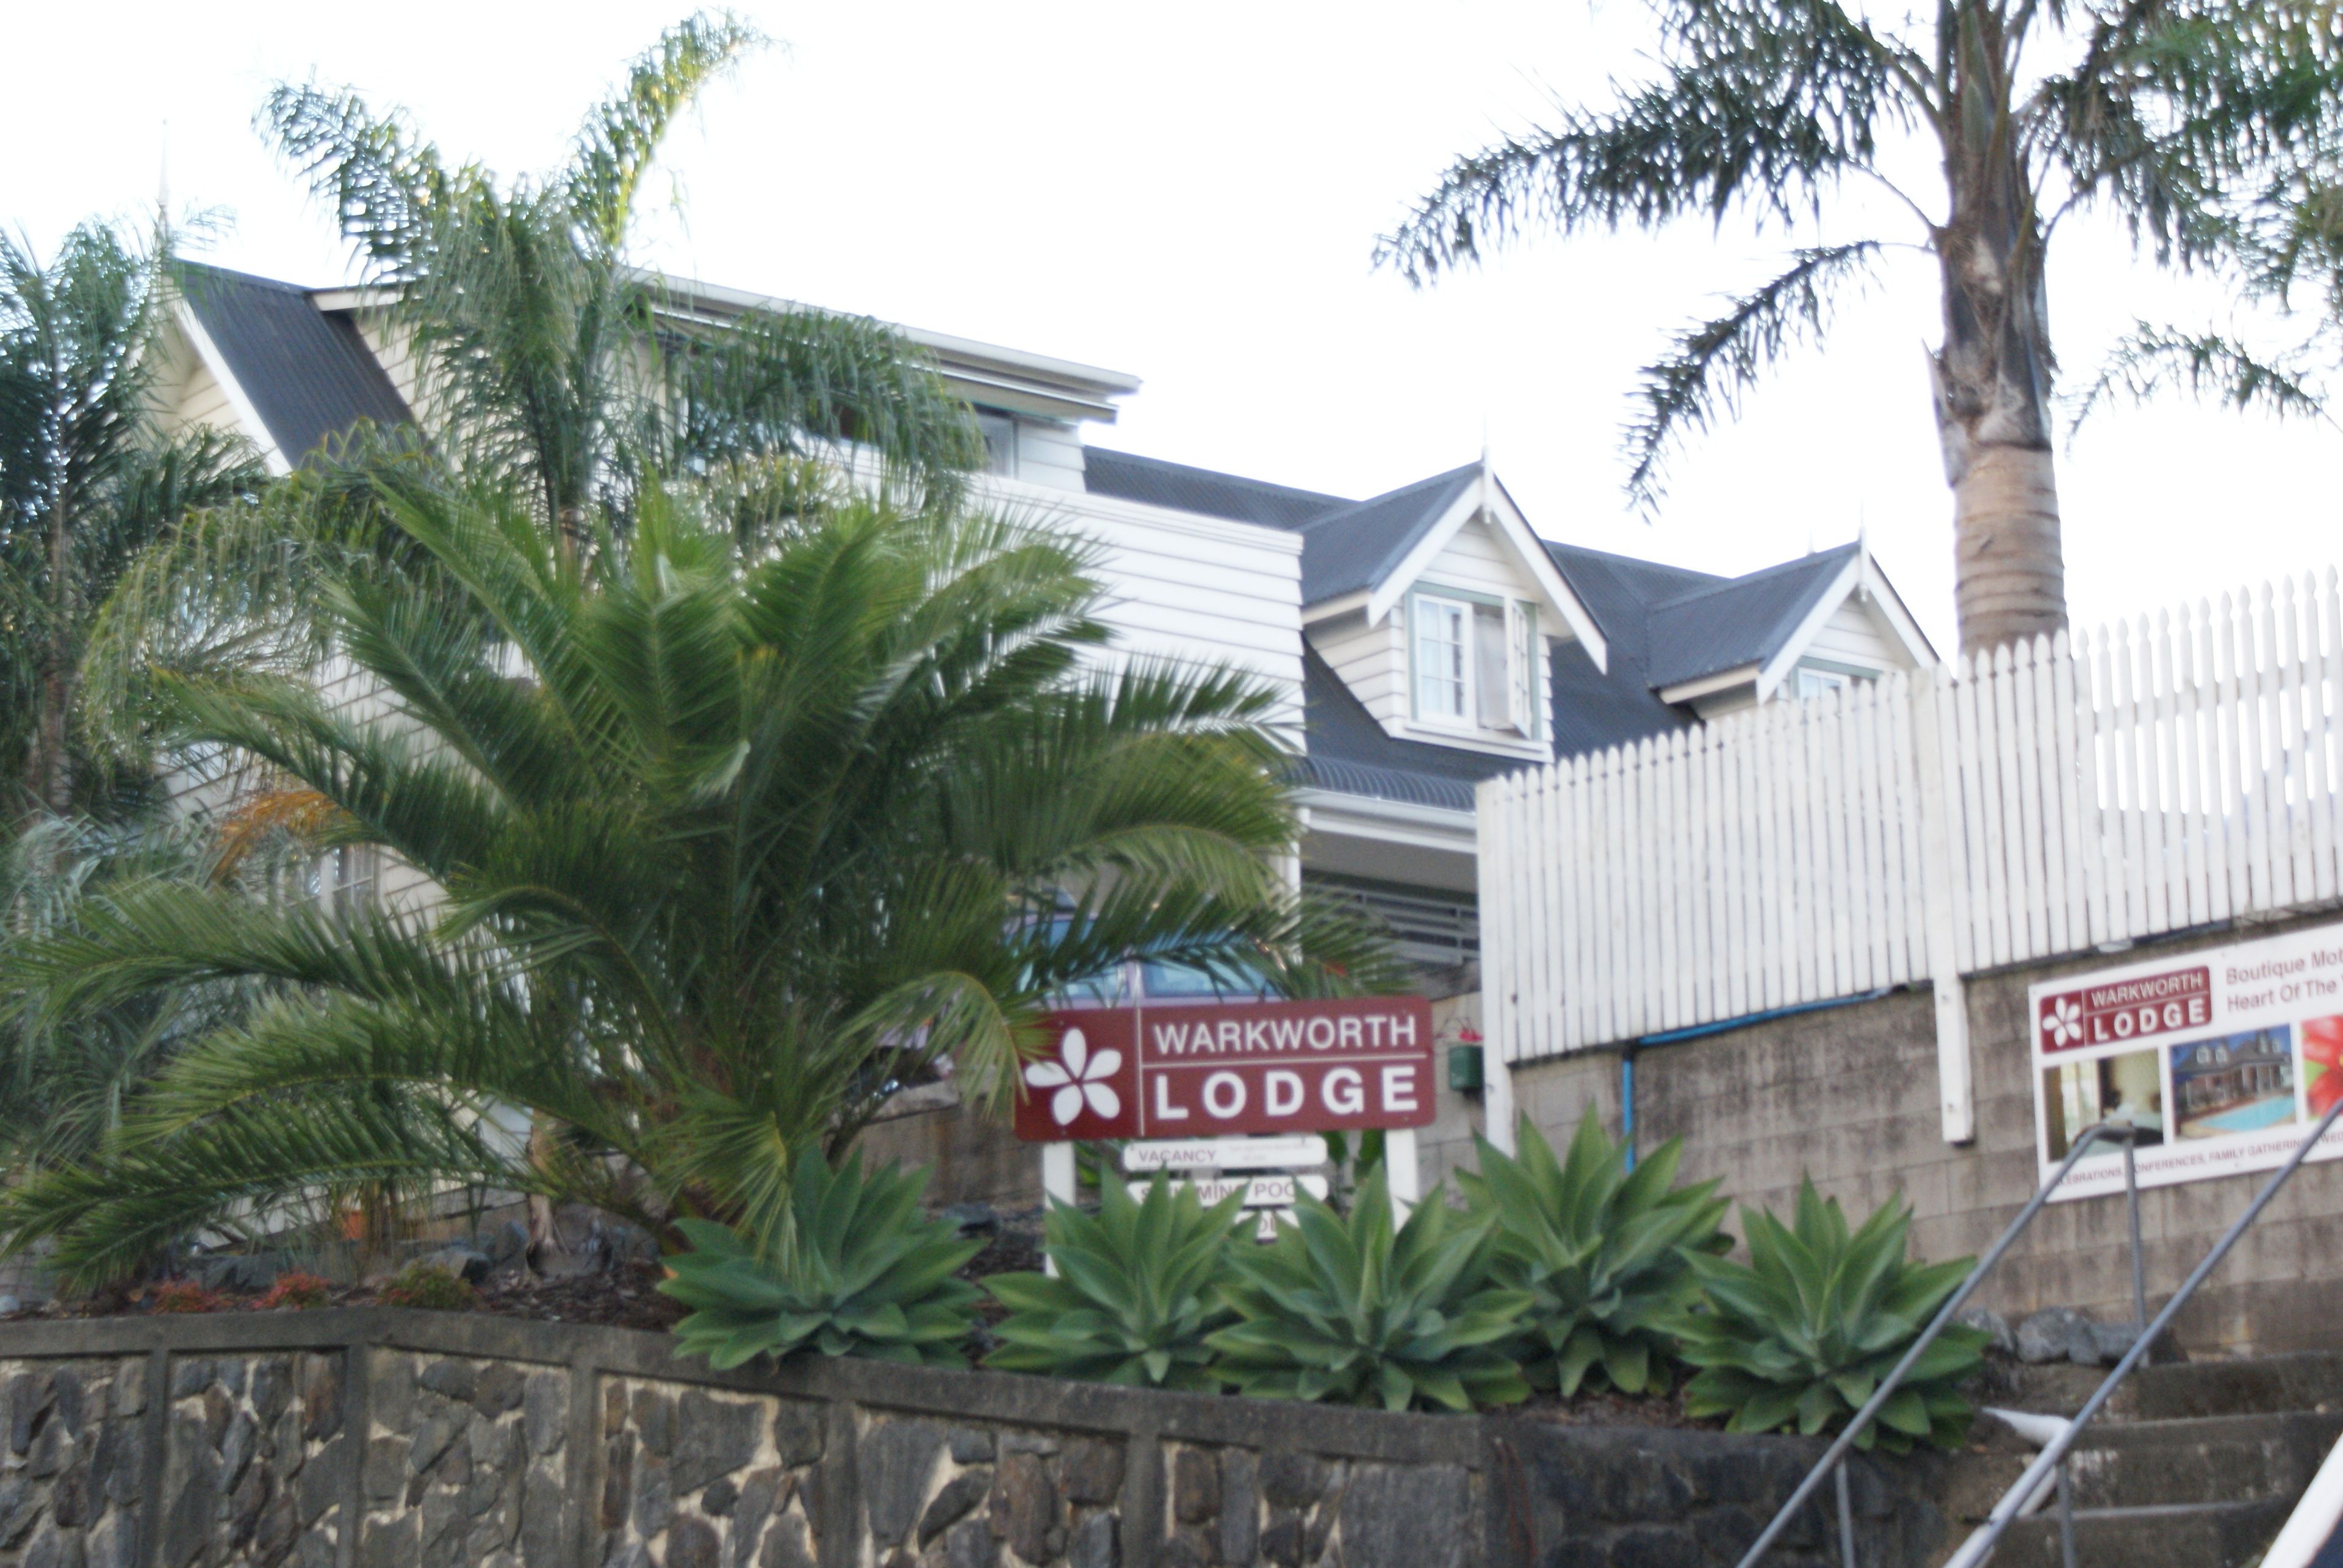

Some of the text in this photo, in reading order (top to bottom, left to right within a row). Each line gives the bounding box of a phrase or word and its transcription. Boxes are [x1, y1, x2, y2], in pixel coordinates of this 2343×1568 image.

[2226, 958, 2305, 984] Boutique
[2091, 972, 2203, 1007] WARKWORTH
[2226, 990, 2274, 1012] Heart
[2280, 983, 2300, 1002] Of
[2303, 979, 2337, 997] The
[1155, 1015, 1416, 1054] WARKWORTH
[2093, 998, 2205, 1041] LODGE
[1156, 1066, 1418, 1120] LODGE
[1139, 1149, 1216, 1162] VACANCY
[2209, 1148, 2244, 1162] FAMILY
